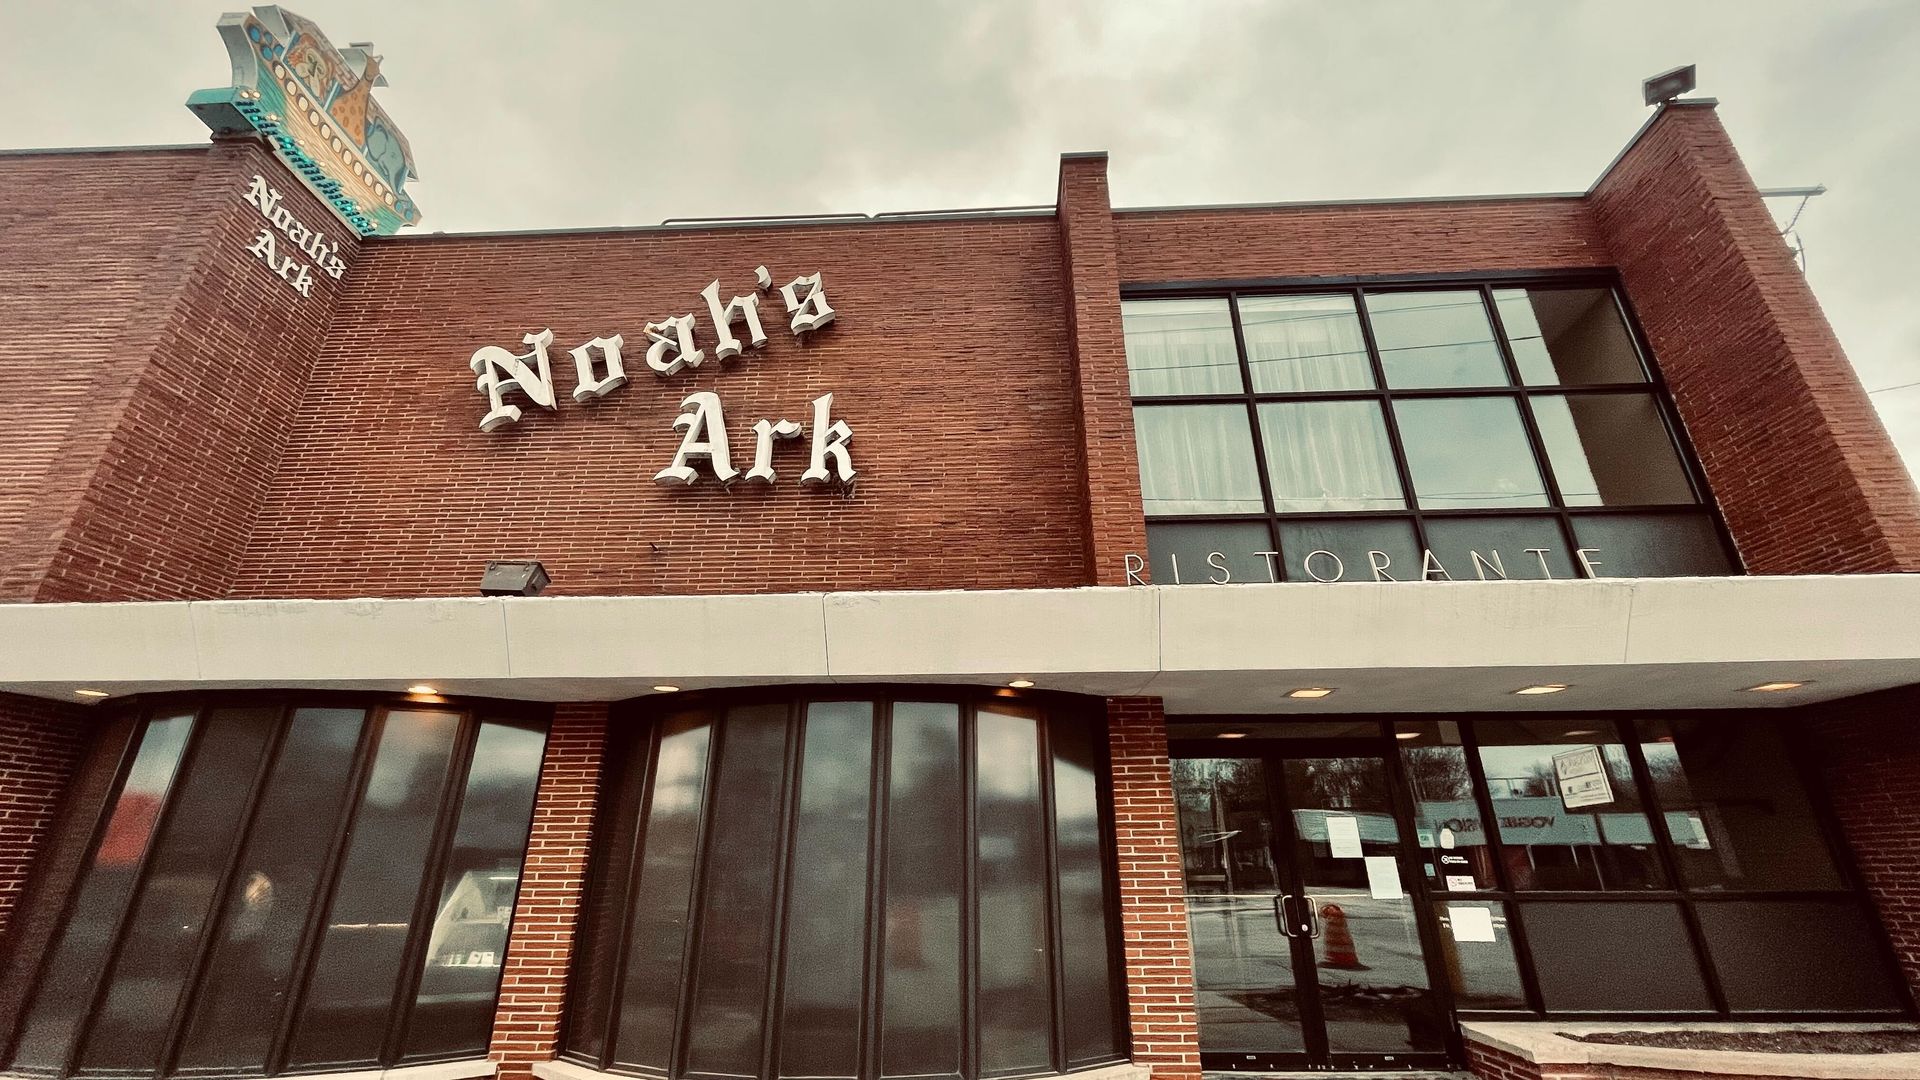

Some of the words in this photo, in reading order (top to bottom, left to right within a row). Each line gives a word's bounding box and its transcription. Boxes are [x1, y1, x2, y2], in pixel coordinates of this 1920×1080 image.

[243, 175, 347, 280] Noah's
[245, 229, 313, 297] Ark
[469, 264, 836, 433] Noah's
[652, 391, 857, 486] Ark
[1125, 547, 1603, 586] RISTORANTE
